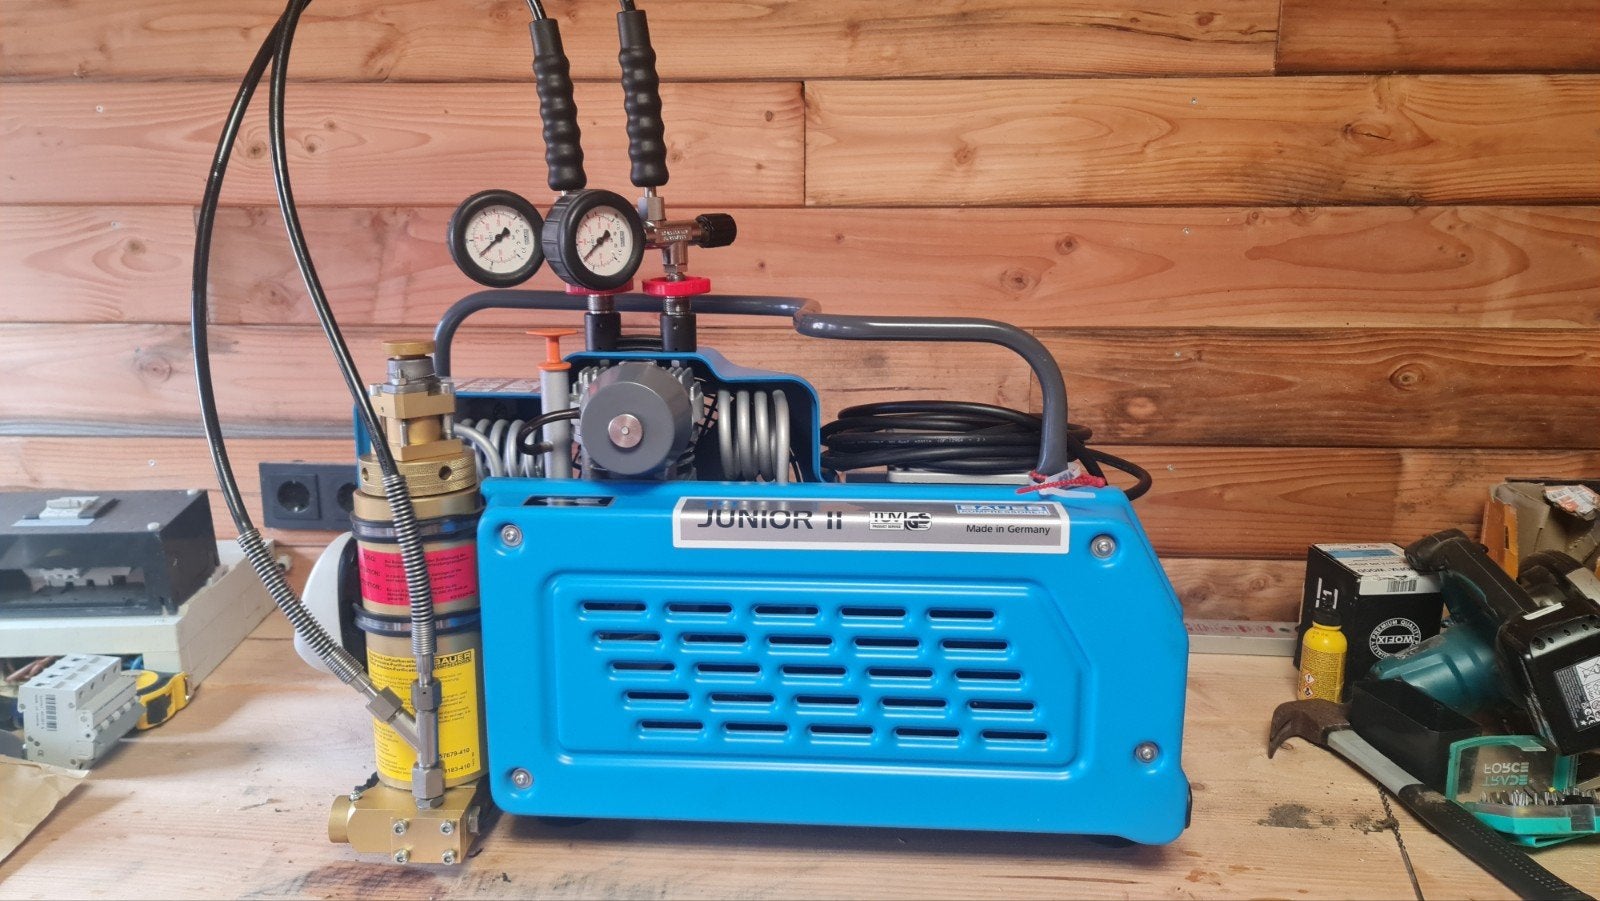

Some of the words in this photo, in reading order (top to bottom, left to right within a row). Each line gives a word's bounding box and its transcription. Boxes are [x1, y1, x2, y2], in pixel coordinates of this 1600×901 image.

[697, 509, 813, 529] JUNIOR
[827, 511, 842, 529] II
[966, 524, 993, 533] Made
[996, 524, 1005, 533] in
[1008, 525, 1050, 536] Germany
[1378, 636, 1413, 644] WOFIX
[434, 652, 472, 665] BAUER
